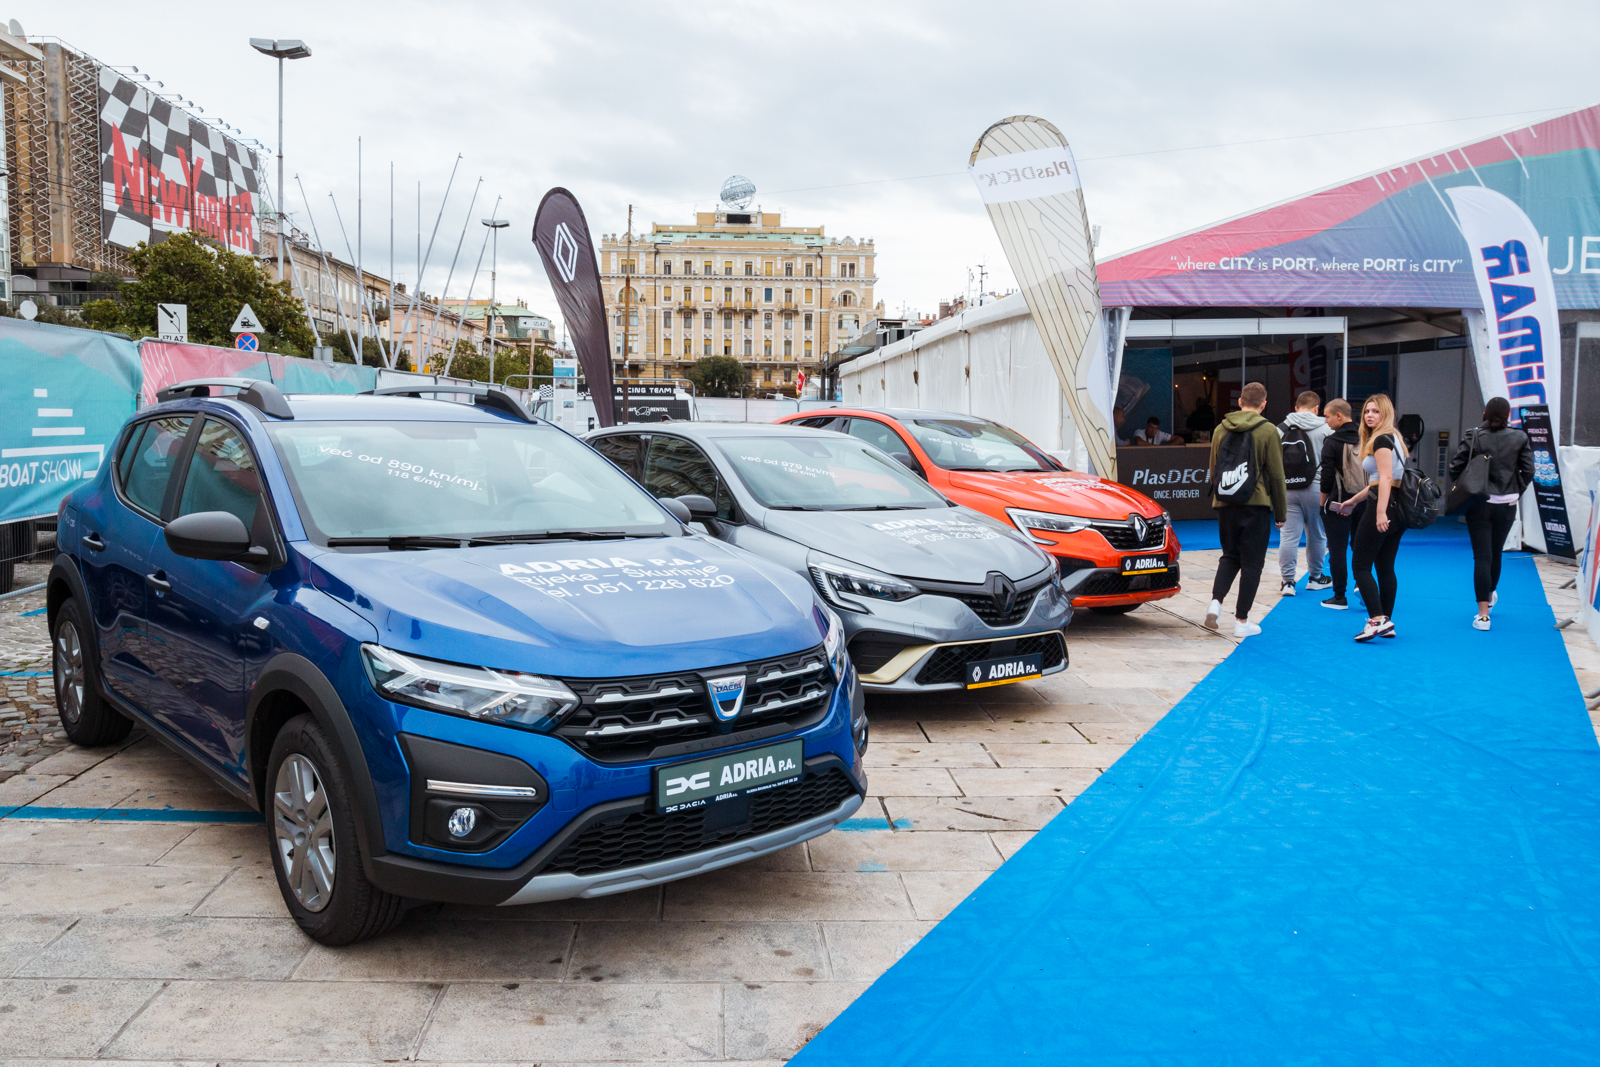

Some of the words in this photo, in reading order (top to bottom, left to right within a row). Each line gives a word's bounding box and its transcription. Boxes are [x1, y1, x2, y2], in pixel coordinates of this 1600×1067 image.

[1219, 257, 1255, 270] CITY
[1258, 258, 1268, 270] is
[1272, 257, 1319, 272] PORT,
[1321, 257, 1360, 271] where
[1363, 258, 1407, 271] PORT
[1409, 260, 1420, 272] is
[0, 461, 39, 488] BOAT
[39, 459, 82, 484] SHOW
[358, 454, 383, 465] od
[388, 460, 424, 474] 890
[429, 469, 483, 491] kn/mj.
[782, 461, 802, 470] 979
[806, 466, 838, 478] kn/mj.
[1222, 461, 1248, 488] NIKE
[387, 469, 409, 479] 118
[414, 476, 444, 489] €/mj.
[1154, 490, 1172, 499] ONCE,
[1172, 489, 1200, 498] FOREVER
[872, 518, 943, 532] ADRIA
[499, 557, 644, 575] ADRIA
[646, 558, 703, 567] P.A.
[1134, 558, 1158, 570] ADRIA
[512, 572, 599, 587] Rijeka
[622, 565, 719, 578] Škurinje
[583, 581, 634, 595] 051
[637, 578, 687, 590] 226
[688, 574, 735, 588] 620
[988, 661, 1025, 679] ADRIA
[1026, 664, 1038, 674] P.A.
[716, 683, 742, 693] DACIA
[720, 755, 776, 786] ADRIA
[778, 758, 796, 773] P.A.
[680, 800, 706, 810] DACIA
[715, 792, 733, 802] ADRIA
